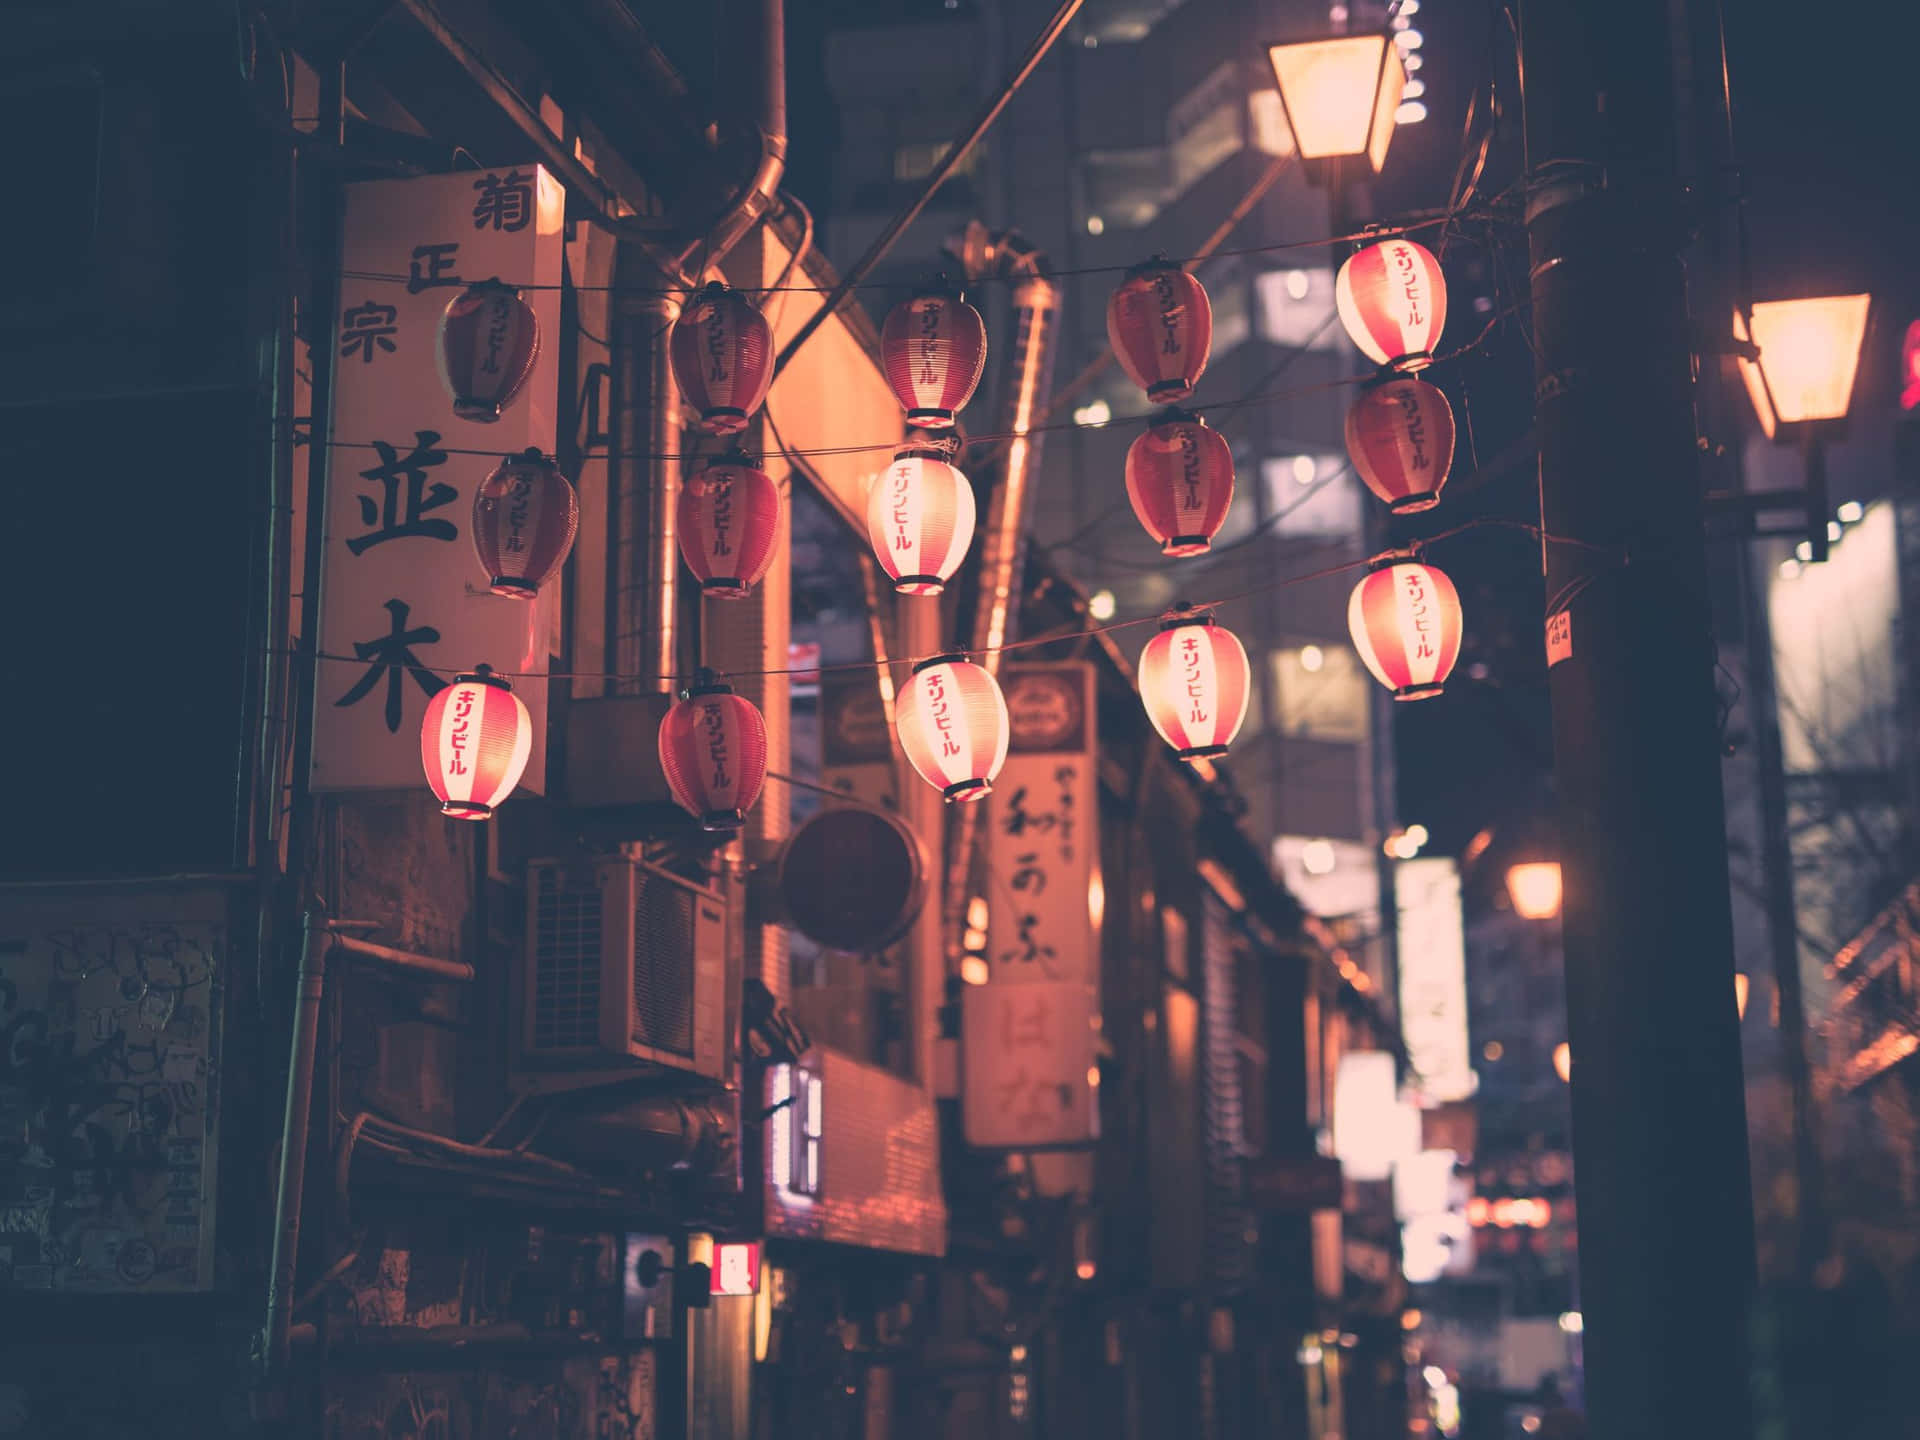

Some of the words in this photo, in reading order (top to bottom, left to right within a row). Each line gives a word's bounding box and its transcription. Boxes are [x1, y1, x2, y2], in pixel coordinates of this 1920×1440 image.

[1393, 245, 1424, 326] キリンビール
[334, 430, 459, 734] 並木
[1405, 574, 1434, 658] キリンビール
[926, 674, 960, 758] キリンビール
[1182, 638, 1208, 723] キリンビール
[449, 690, 475, 775] キリンビール
